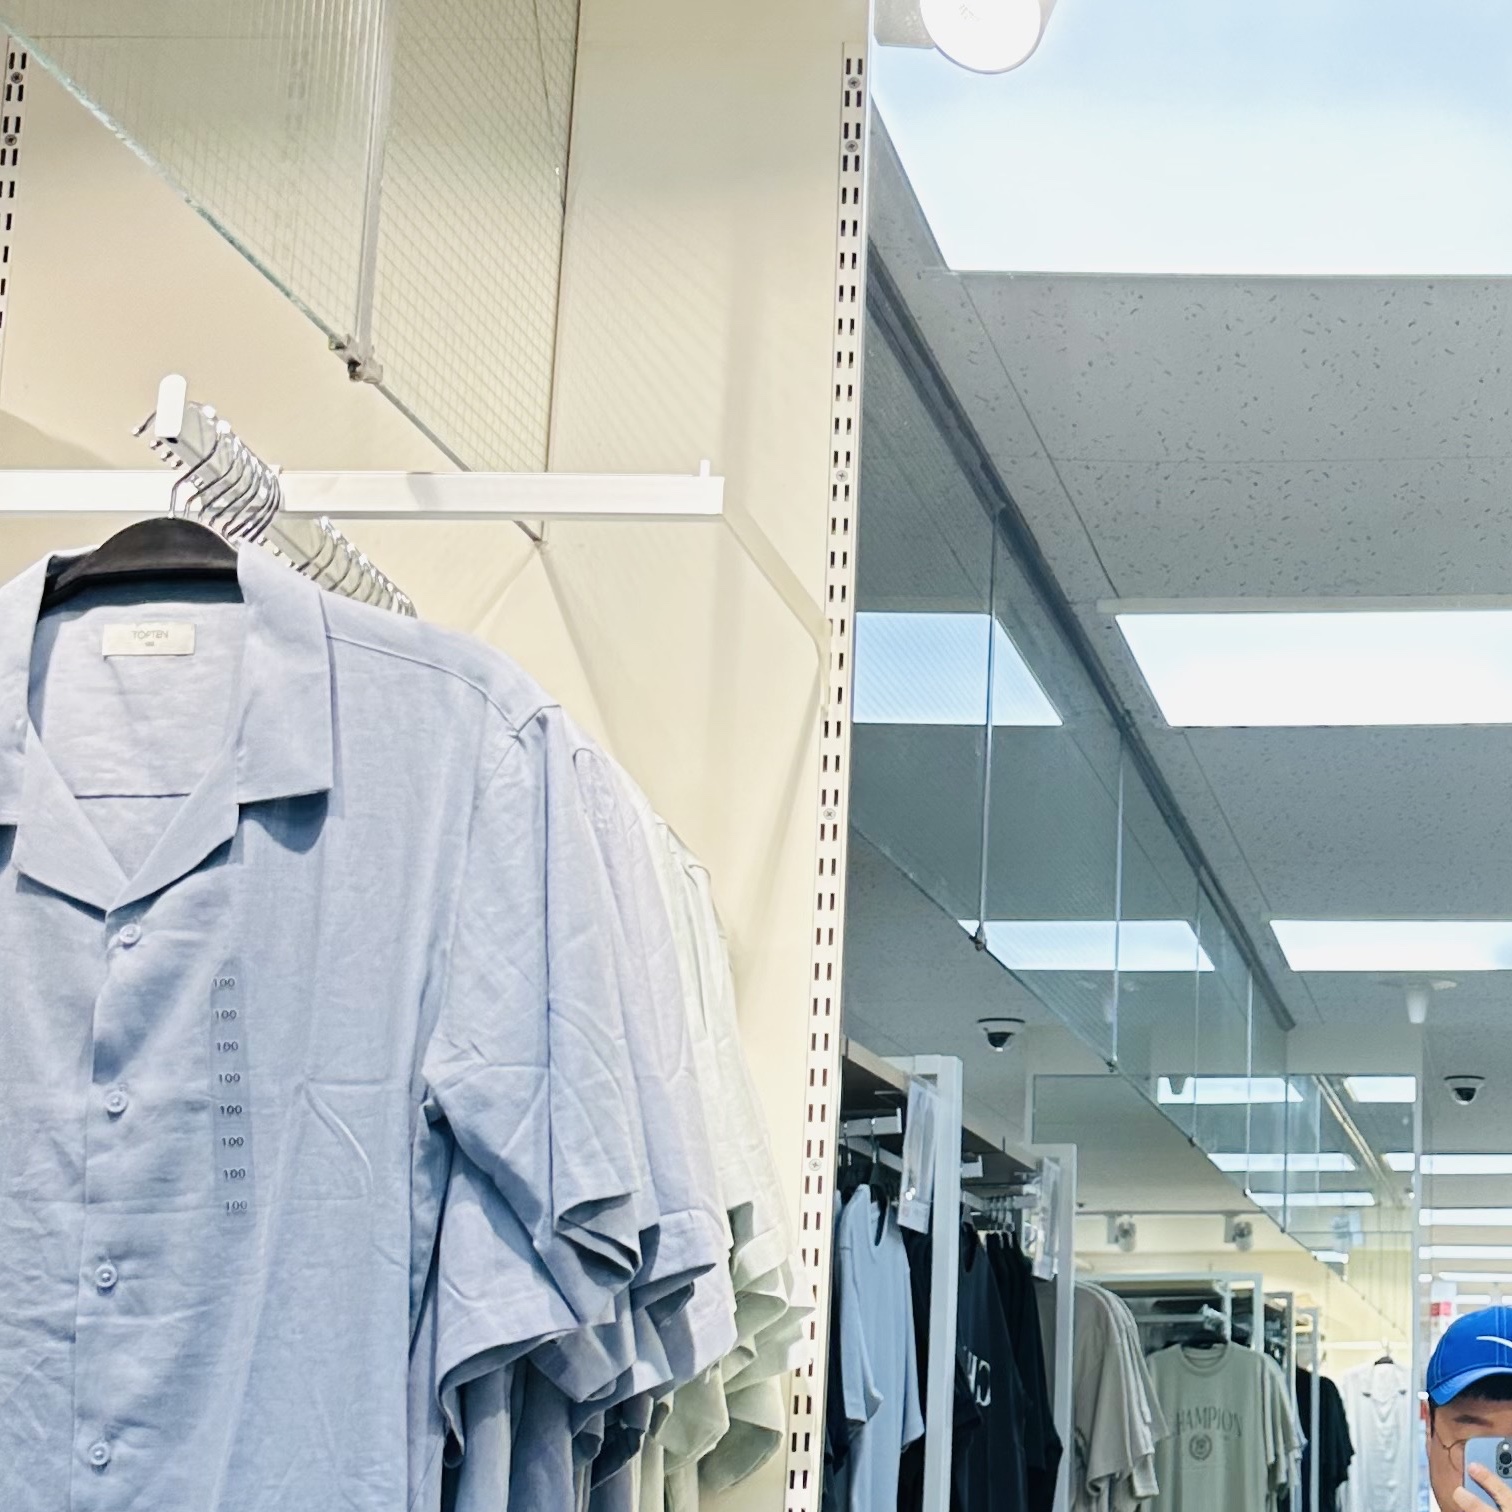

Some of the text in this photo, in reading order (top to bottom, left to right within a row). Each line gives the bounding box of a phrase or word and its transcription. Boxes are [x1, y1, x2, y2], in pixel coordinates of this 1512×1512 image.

[213, 978, 236, 988] 100
[215, 1010, 237, 1020] 100
[217, 1041, 239, 1051] 100
[219, 1073, 241, 1083] 100
[220, 1105, 242, 1115] 100
[222, 1137, 244, 1147] 100
[224, 1168, 246, 1179] 100
[226, 1200, 248, 1211] 100
